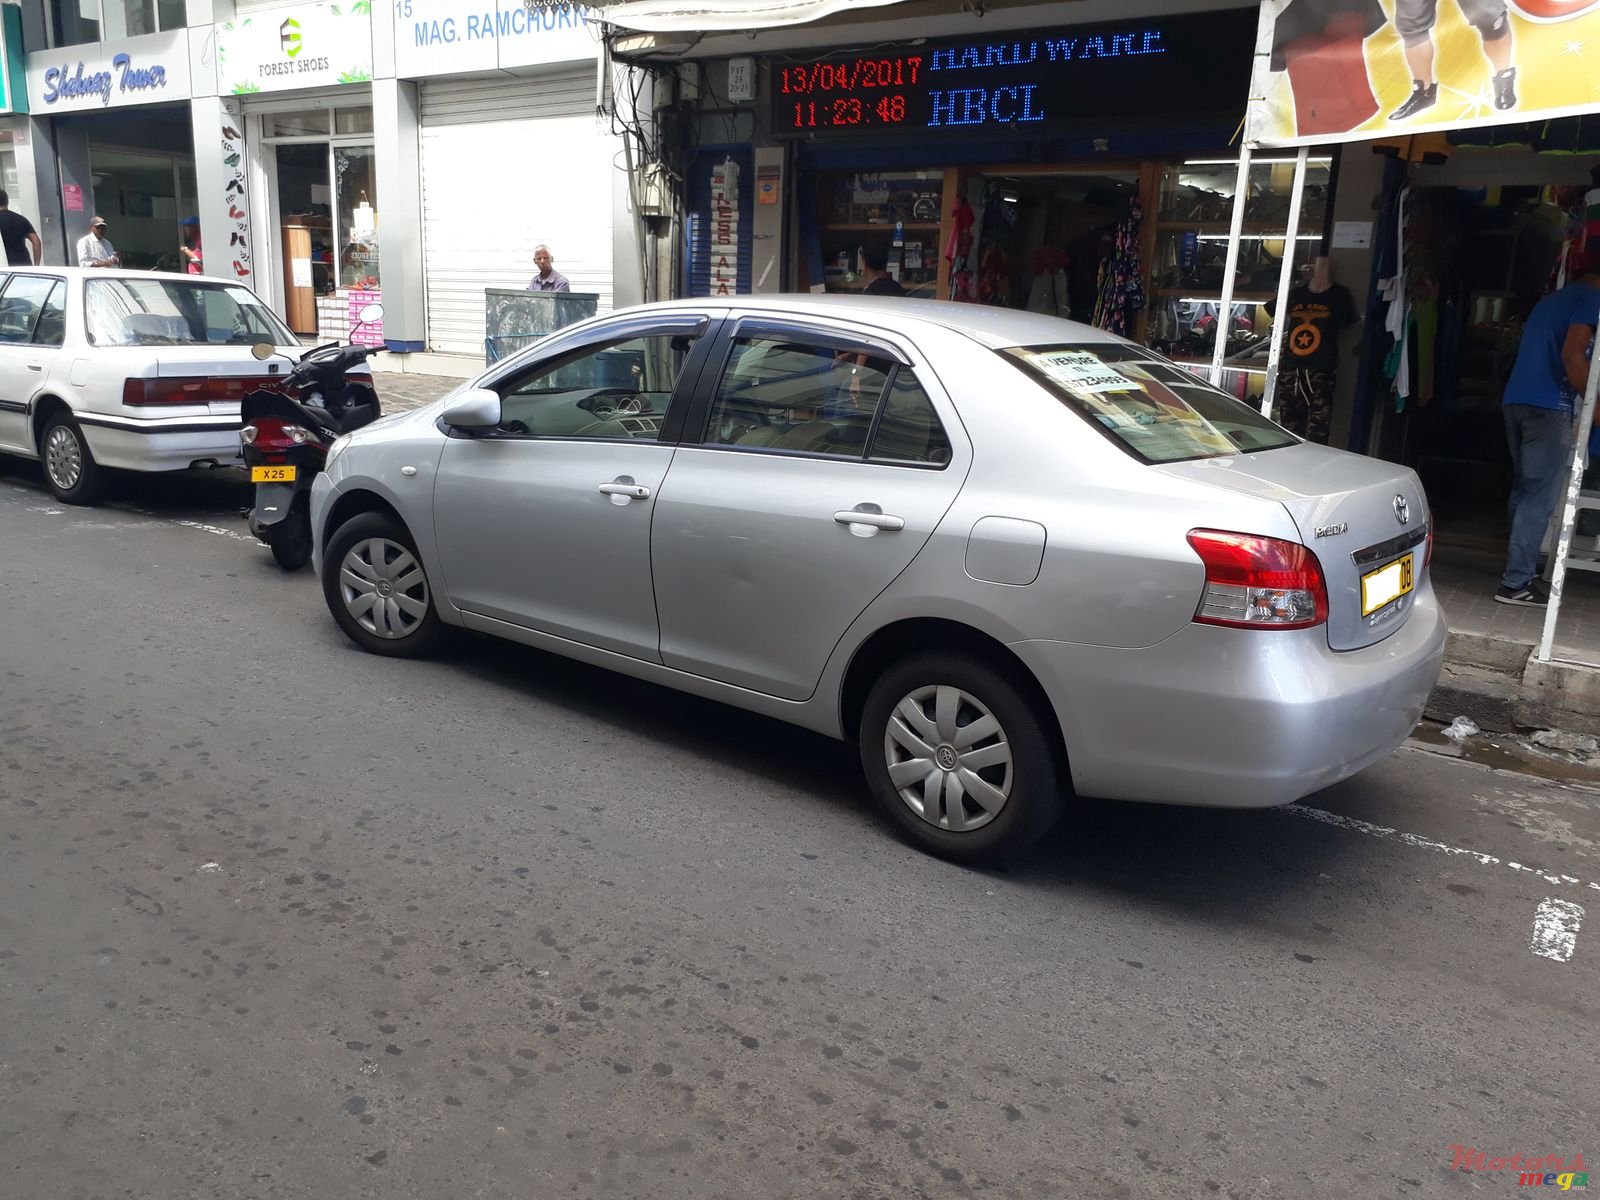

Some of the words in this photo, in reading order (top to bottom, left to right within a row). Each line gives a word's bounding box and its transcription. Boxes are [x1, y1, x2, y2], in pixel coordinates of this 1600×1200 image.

[395, 0, 412, 19] 15
[414, 18, 461, 47] MAG.
[113, 53, 167, 94] Tower
[259, 61, 294, 77] FOREST
[298, 57, 329, 73] SHOES
[782, 56, 921, 94] 13/04/2017
[794, 95, 905, 127] 11:23:48
[928, 84, 1044, 126] HBCL
[264, 471, 270, 479] X
[272, 470, 285, 479] 25
